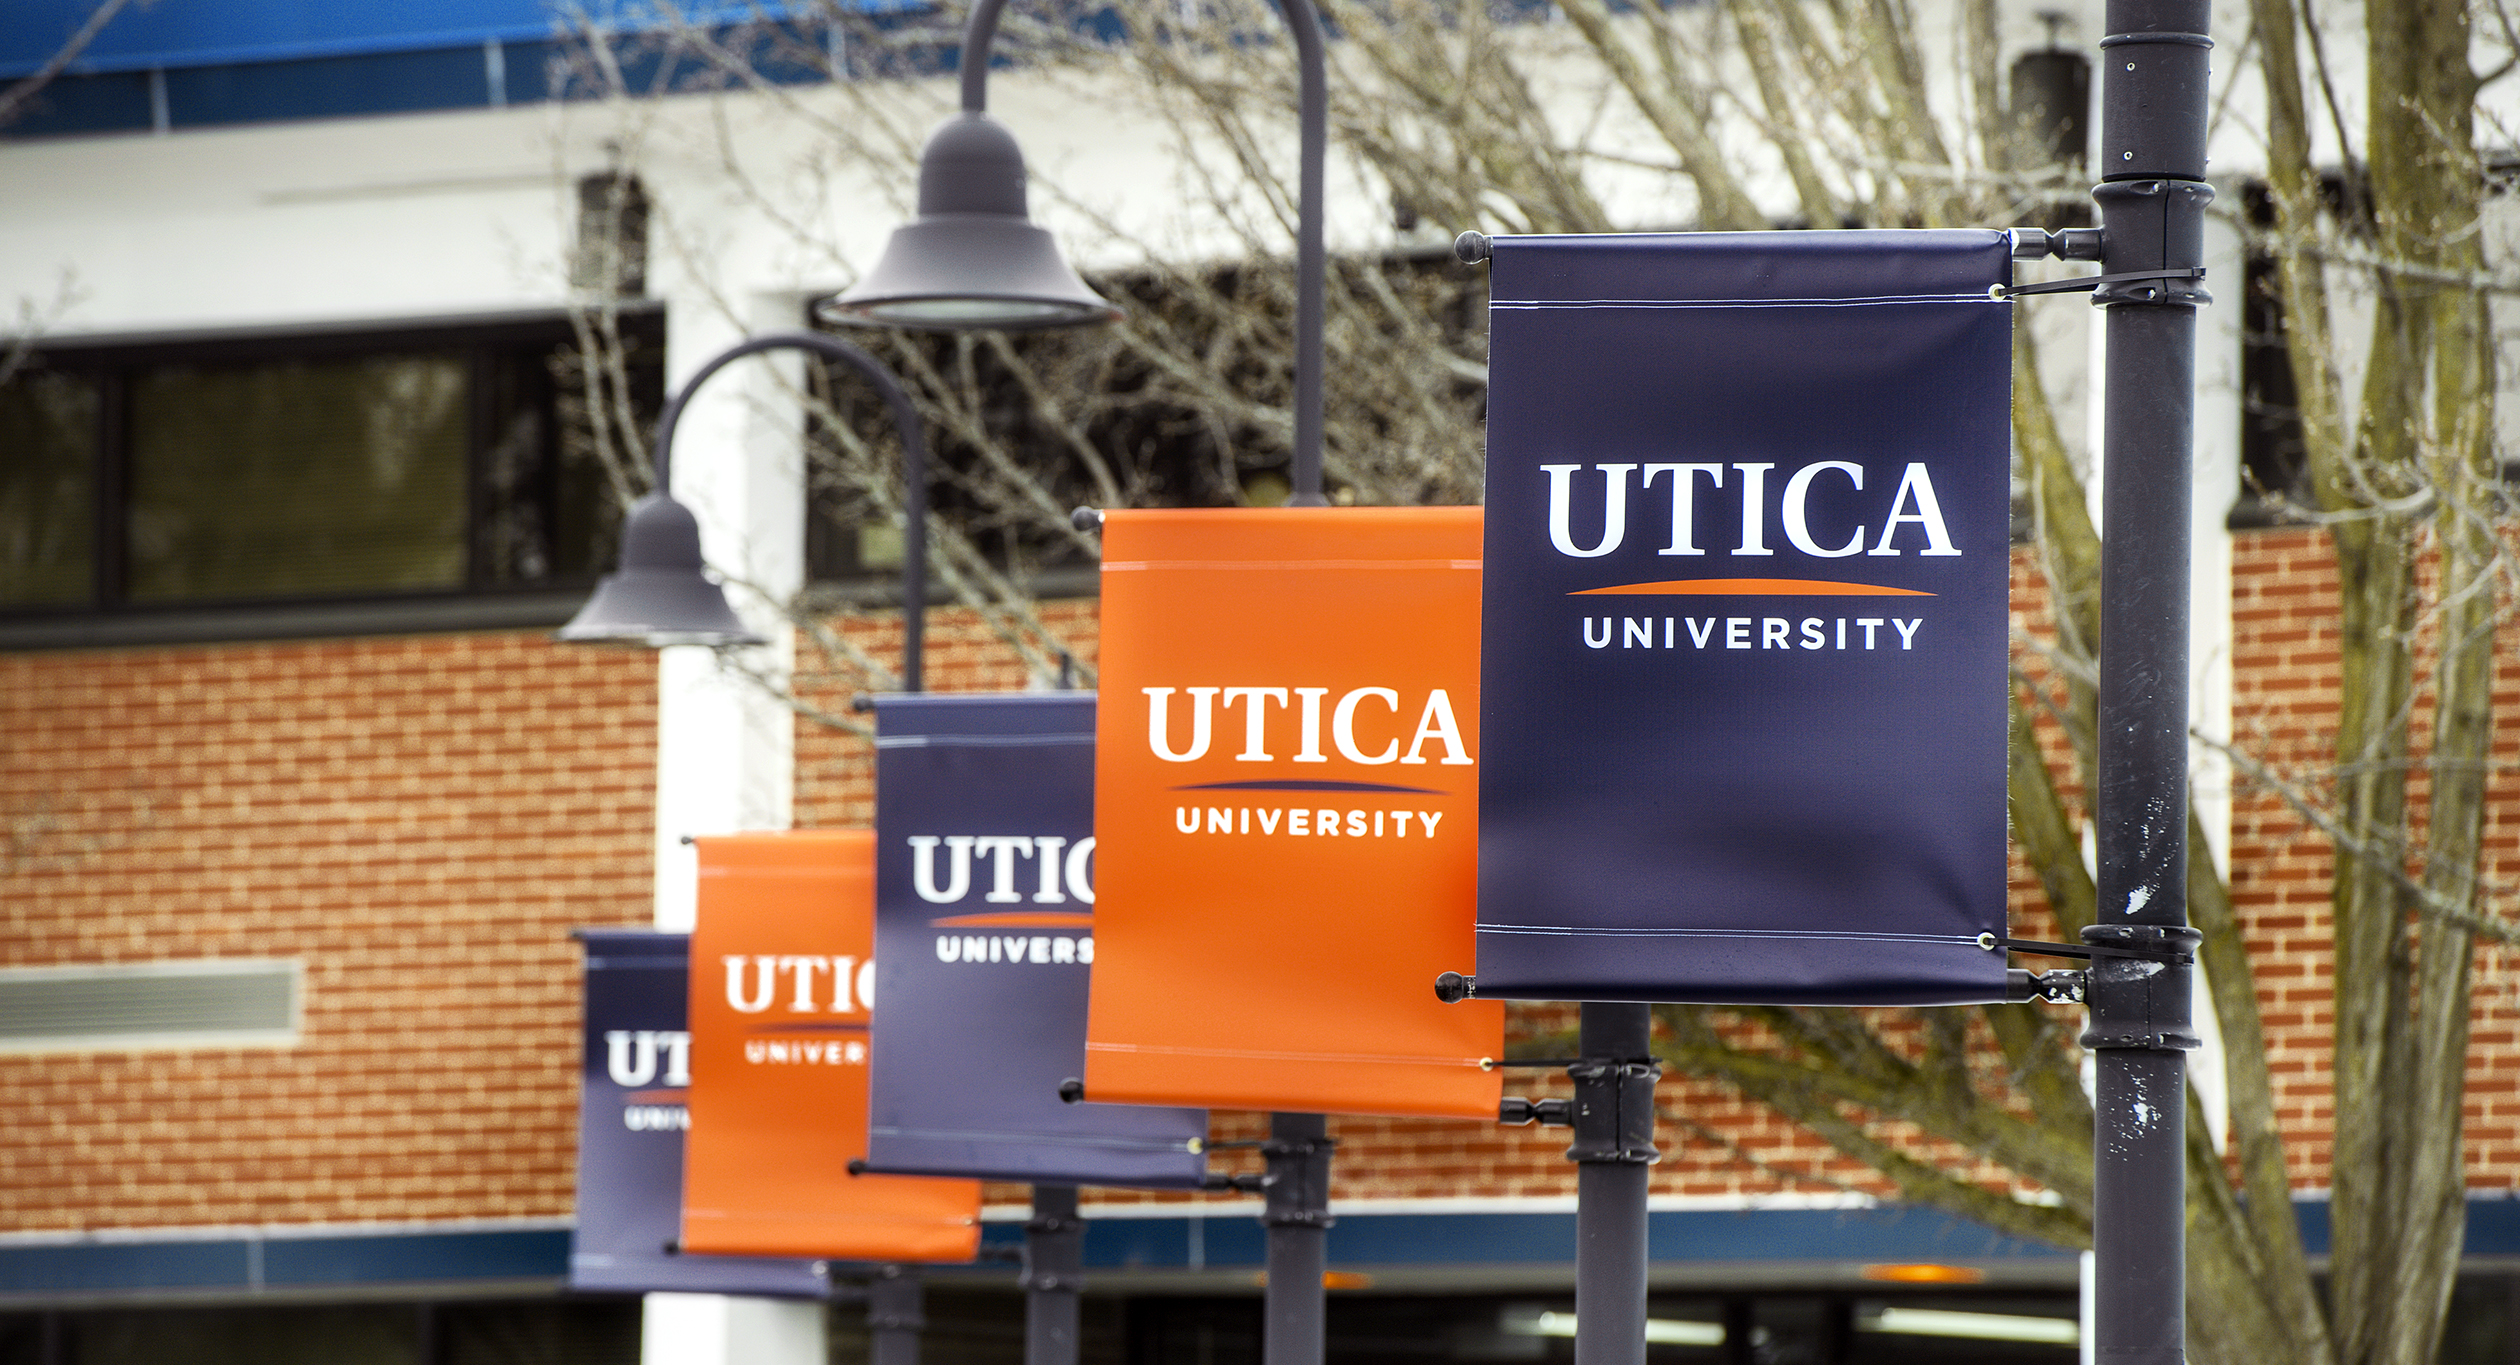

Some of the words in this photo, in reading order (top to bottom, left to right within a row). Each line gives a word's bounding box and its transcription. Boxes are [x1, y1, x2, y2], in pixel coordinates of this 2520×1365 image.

[1540, 461, 1963, 558] UTICA
[1583, 617, 1924, 651] UNIVERSITY
[1141, 686, 1475, 765] UTICA
[1176, 807, 1443, 838] UNIVERSITY
[745, 1039, 867, 1065] UNIVER
